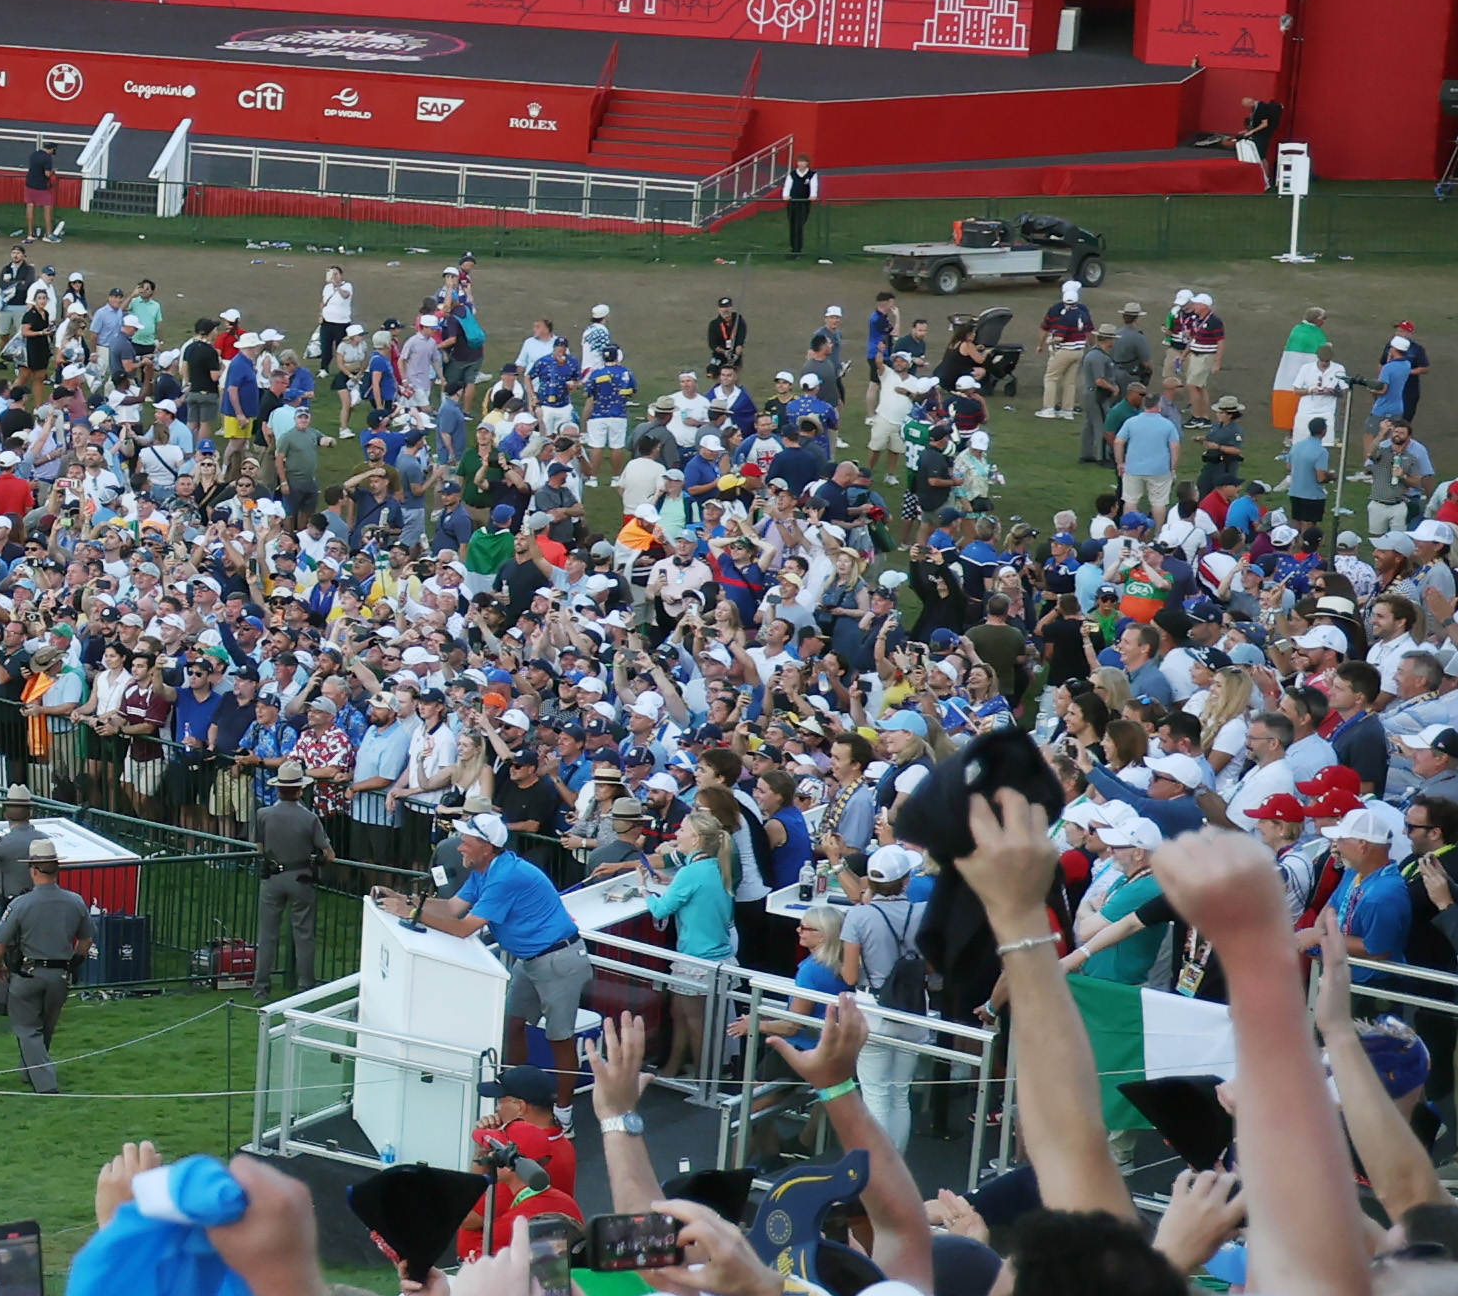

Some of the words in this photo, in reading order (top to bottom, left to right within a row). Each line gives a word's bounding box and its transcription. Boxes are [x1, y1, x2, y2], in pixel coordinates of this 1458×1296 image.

[123, 81, 182, 99] Capgemini
[237, 82, 285, 111] citi
[323, 108, 338, 117] DP
[338, 109, 372, 119] WORLD
[418, 101, 452, 116] SAP
[508, 117, 558, 131] ROLEX
